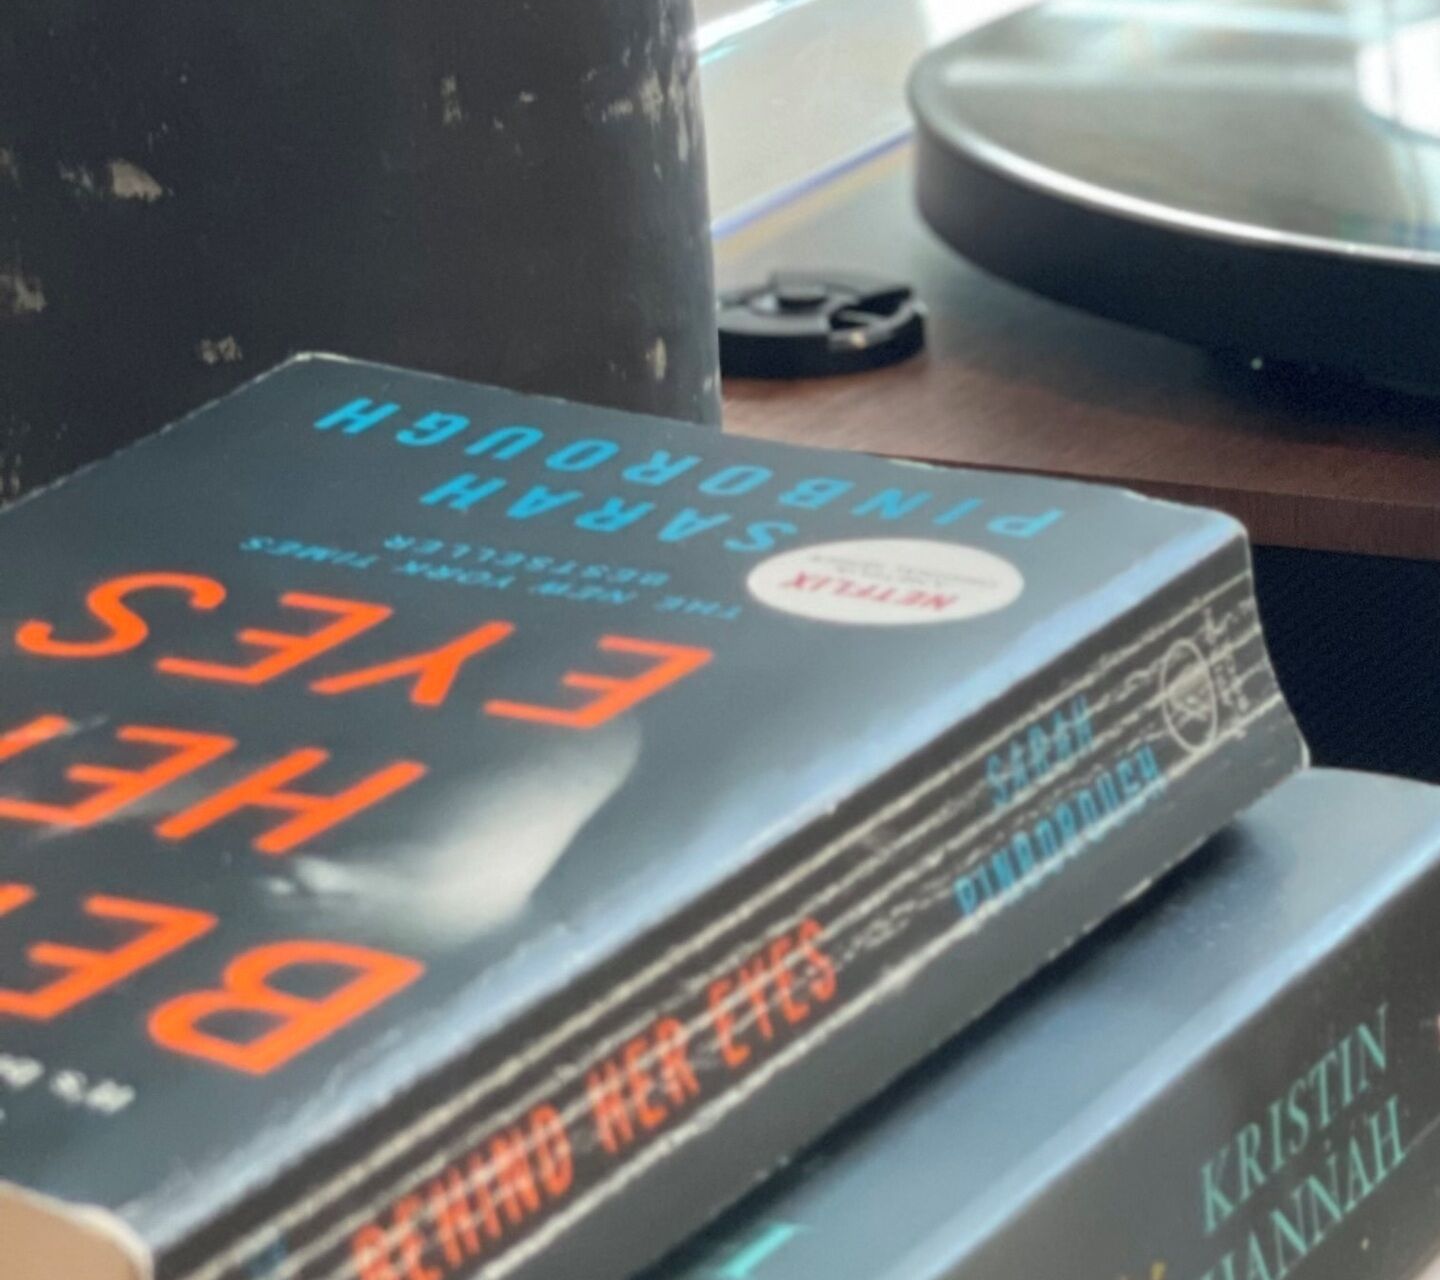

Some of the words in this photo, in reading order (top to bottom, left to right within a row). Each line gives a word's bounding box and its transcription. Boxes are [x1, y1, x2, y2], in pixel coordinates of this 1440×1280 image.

[312, 397, 1066, 540] PINBOROUGH
[239, 535, 380, 570] TIMES
[420, 472, 798, 554] SARAH
[383, 534, 671, 587] BESTSELLER
[394, 560, 516, 590] YORK
[528, 580, 637, 605] NEW
[780, 570, 958, 613] NETFLIX
[655, 595, 743, 621] THE
[14, 571, 715, 729] EYES
[984, 695, 1098, 810] SARAH
[953, 744, 1167, 918] PINBOROUGH
[586, 1016, 700, 1154] HER
[707, 917, 838, 1067] EYES
[1201, 1003, 1389, 1237] KRISTIN
